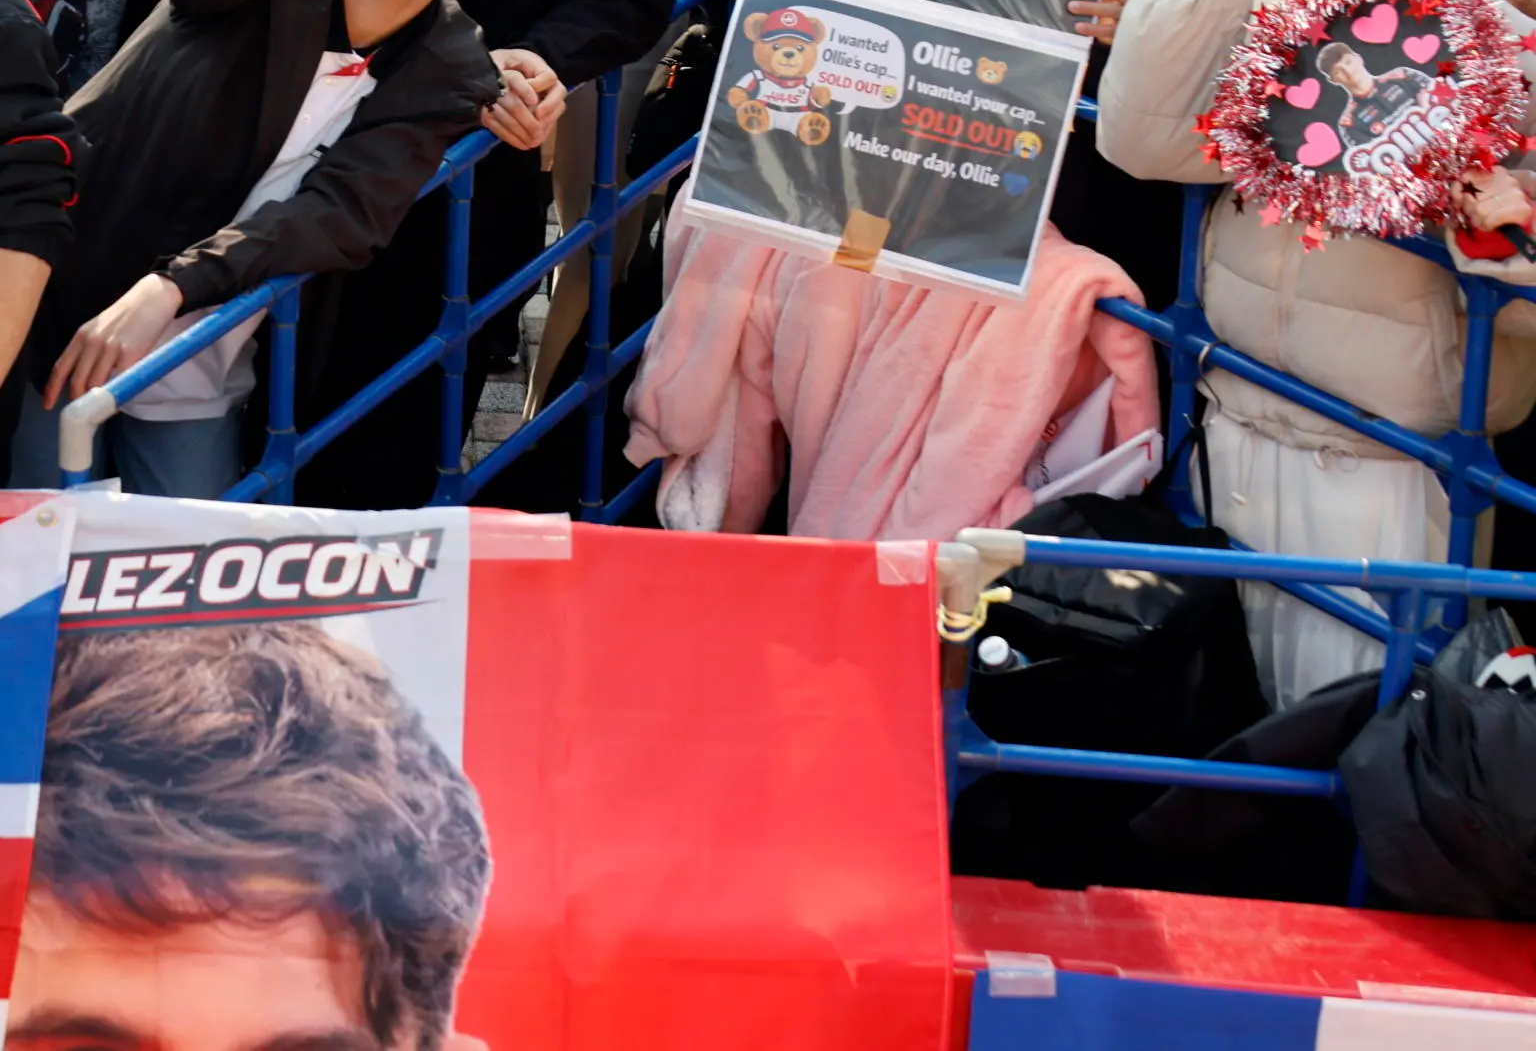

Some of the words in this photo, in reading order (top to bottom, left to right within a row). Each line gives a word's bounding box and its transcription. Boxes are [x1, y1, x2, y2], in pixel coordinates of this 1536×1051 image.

[821, 48, 862, 70] Ollie's
[829, 28, 836, 43] I
[838, 32, 890, 54] wanted
[911, 40, 974, 76] Ollie
[818, 70, 852, 90] SOLD
[854, 78, 882, 97] OUT
[907, 78, 916, 91] I
[917, 83, 972, 106] wanted
[972, 93, 1008, 116] your
[900, 102, 964, 137] SOLD
[966, 121, 1016, 152] OUT
[843, 130, 891, 161] Make
[892, 147, 922, 167] our
[922, 154, 959, 180] day,
[959, 162, 1001, 188] Ollie
[61, 550, 194, 614] LEZ
[195, 533, 432, 606] OCON
